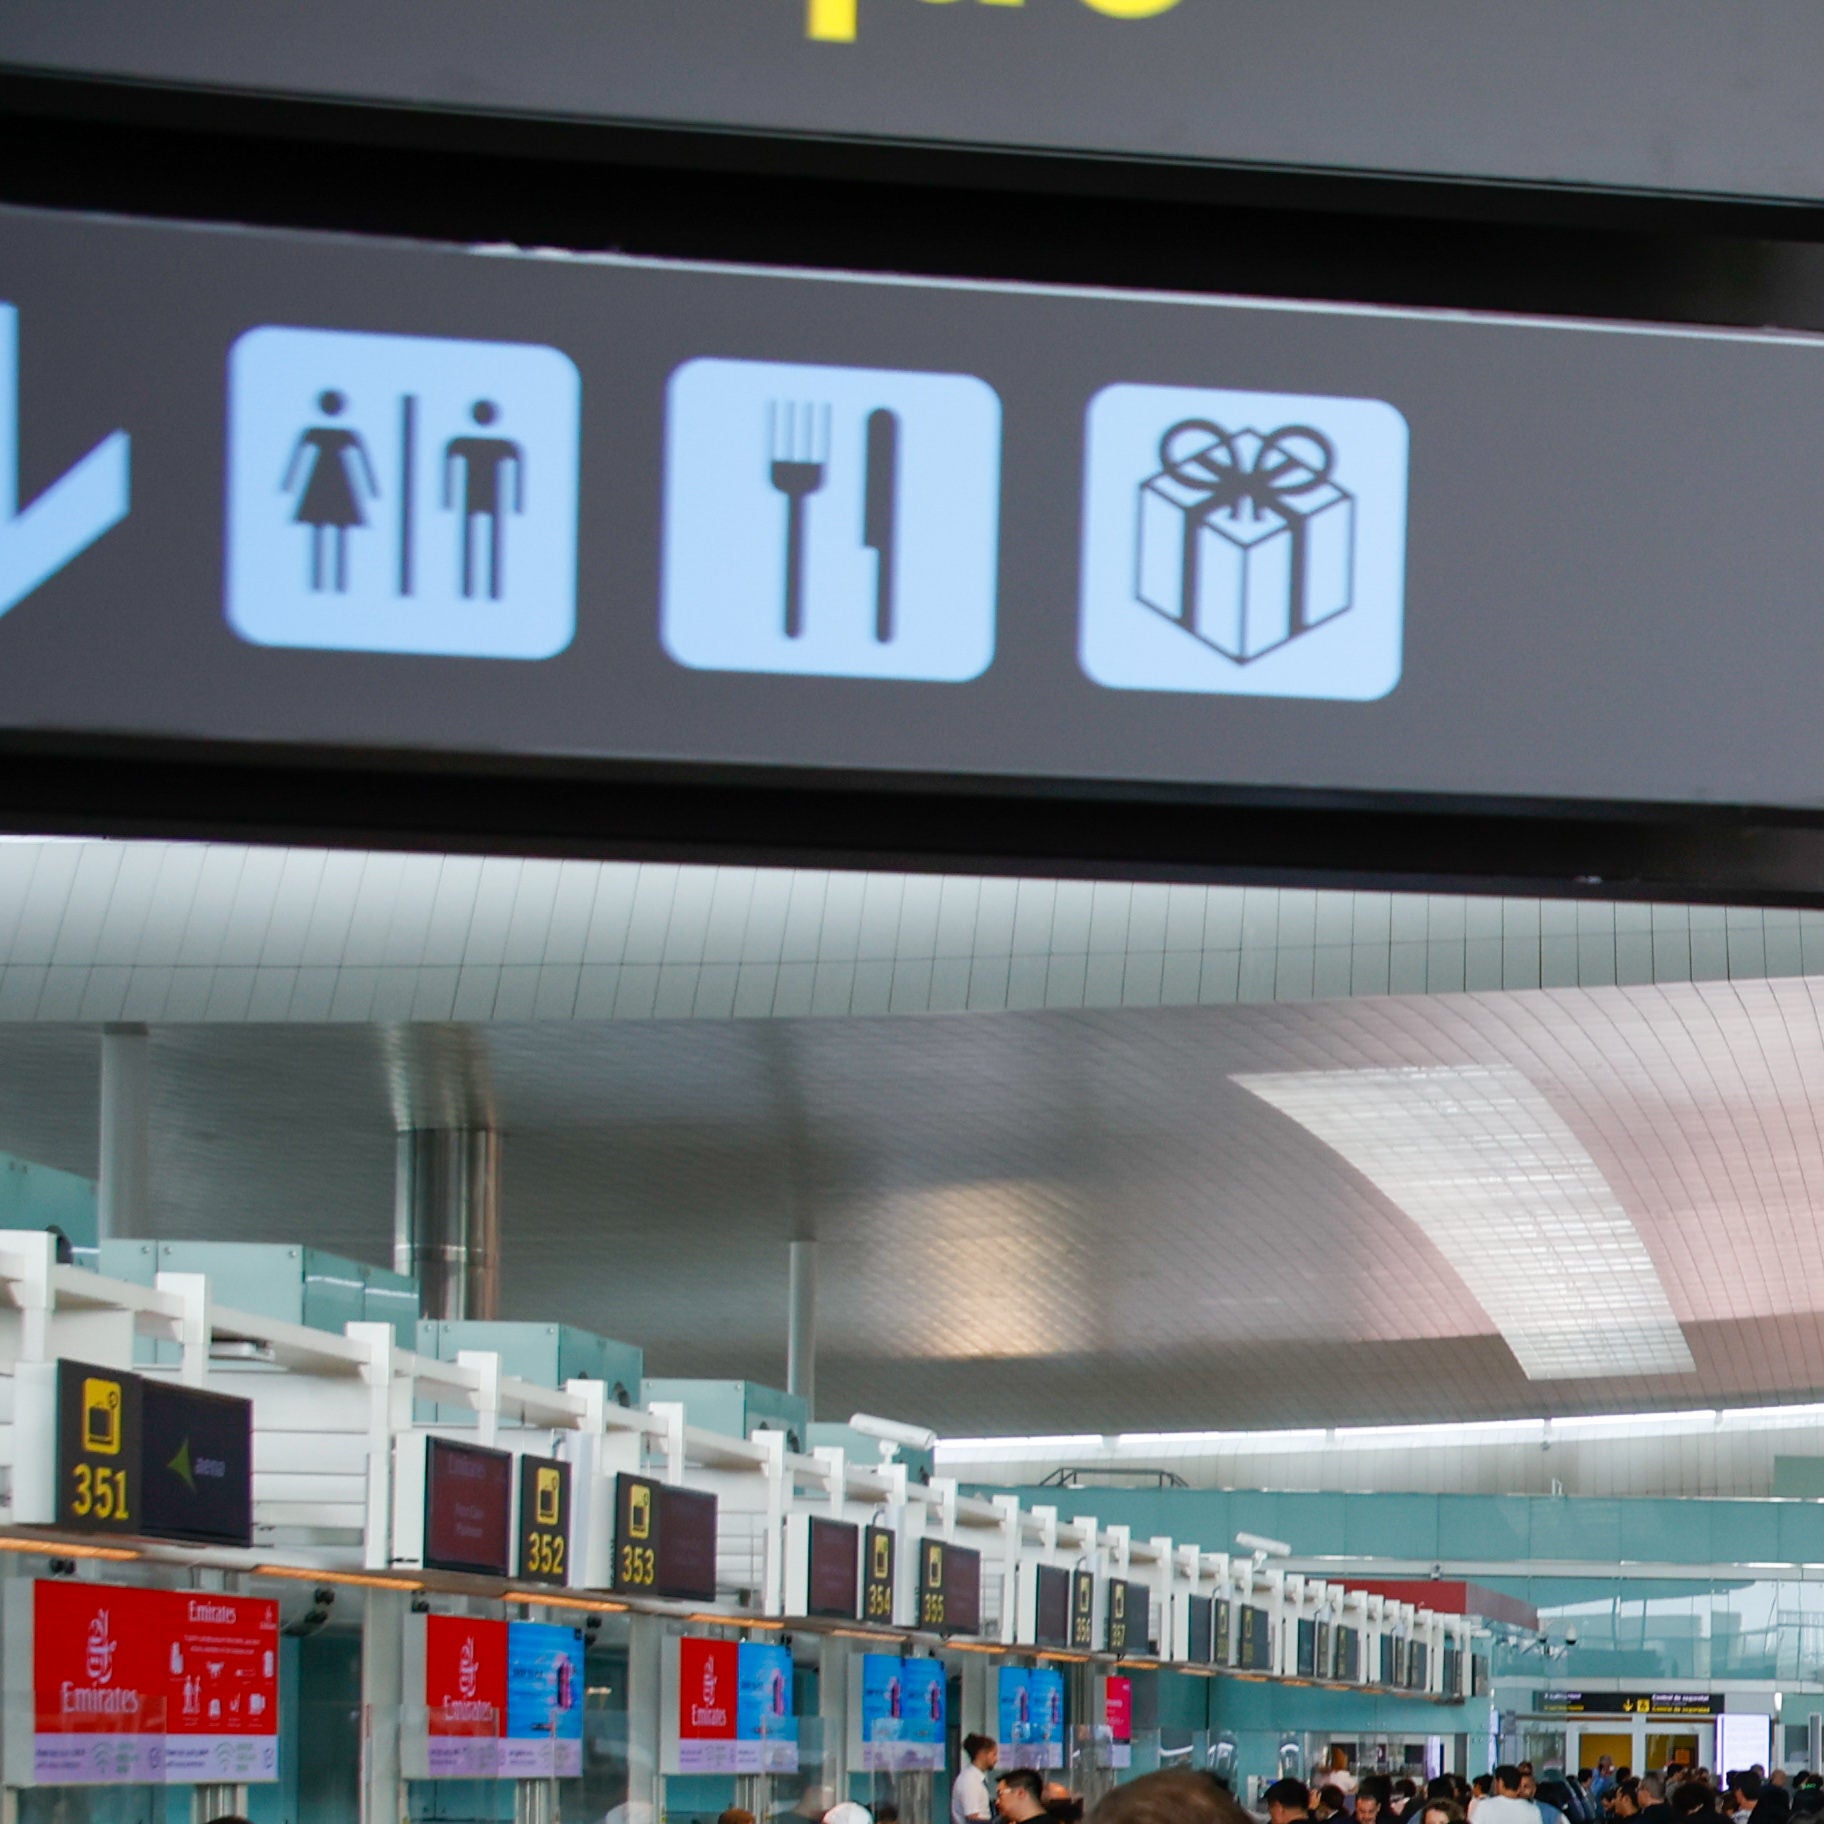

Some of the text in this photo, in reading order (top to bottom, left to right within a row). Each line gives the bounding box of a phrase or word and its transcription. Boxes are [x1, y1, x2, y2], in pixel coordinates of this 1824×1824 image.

[72, 1462, 130, 1521] 351
[528, 1532, 565, 1575] 352
[621, 1544, 656, 1586] 353
[188, 1600, 237, 1624] Emirates
[868, 1583, 892, 1615] 354
[924, 1595, 944, 1623] 355
[61, 1680, 141, 1715] Emirates
[443, 1695, 495, 1722] Emirates
[691, 1704, 728, 1727] Emirates
